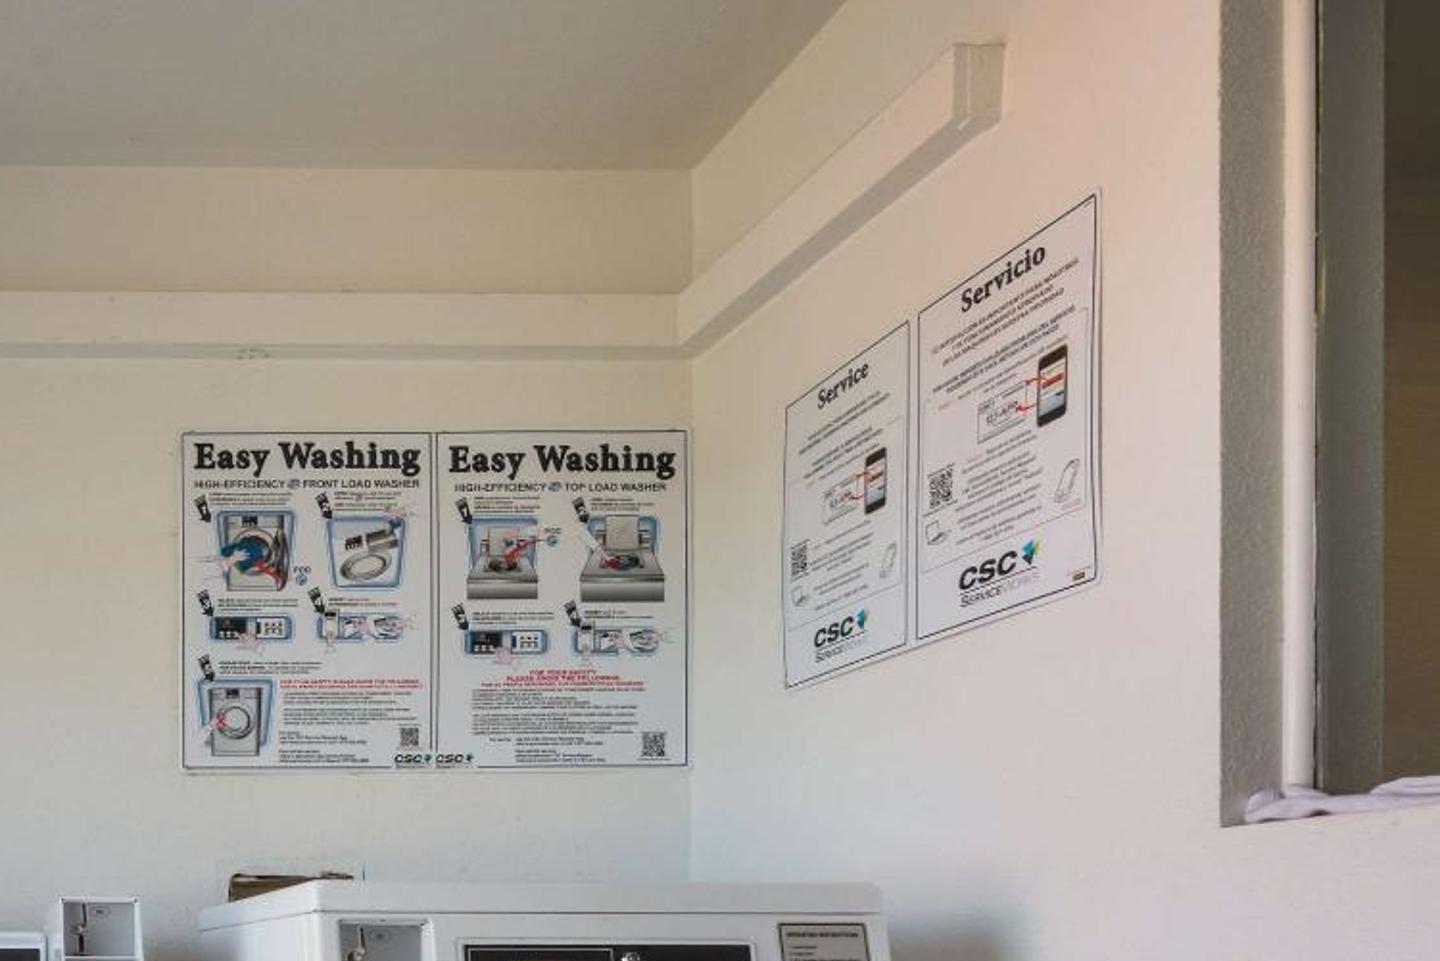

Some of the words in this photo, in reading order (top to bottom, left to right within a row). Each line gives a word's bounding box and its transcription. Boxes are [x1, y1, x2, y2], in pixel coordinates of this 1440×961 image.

[961, 247, 1046, 313] Servicio
[817, 363, 869, 410] Service
[193, 442, 271, 478] Easy
[278, 441, 421, 477] Washing
[449, 445, 526, 480] Easy
[533, 443, 676, 480] Washing
[194, 479, 285, 489] HIGH-EFFICIENCY
[303, 479, 338, 489] FRONT
[341, 479, 371, 489] LOAD
[374, 479, 420, 489] WASHER
[454, 482, 546, 492] HIGH-EFFICIENCY
[565, 482, 585, 492] TOP
[588, 482, 618, 492] LOAD
[620, 482, 667, 492] WASHER
[959, 551, 1017, 591] CSC
[814, 616, 854, 648] CSC
